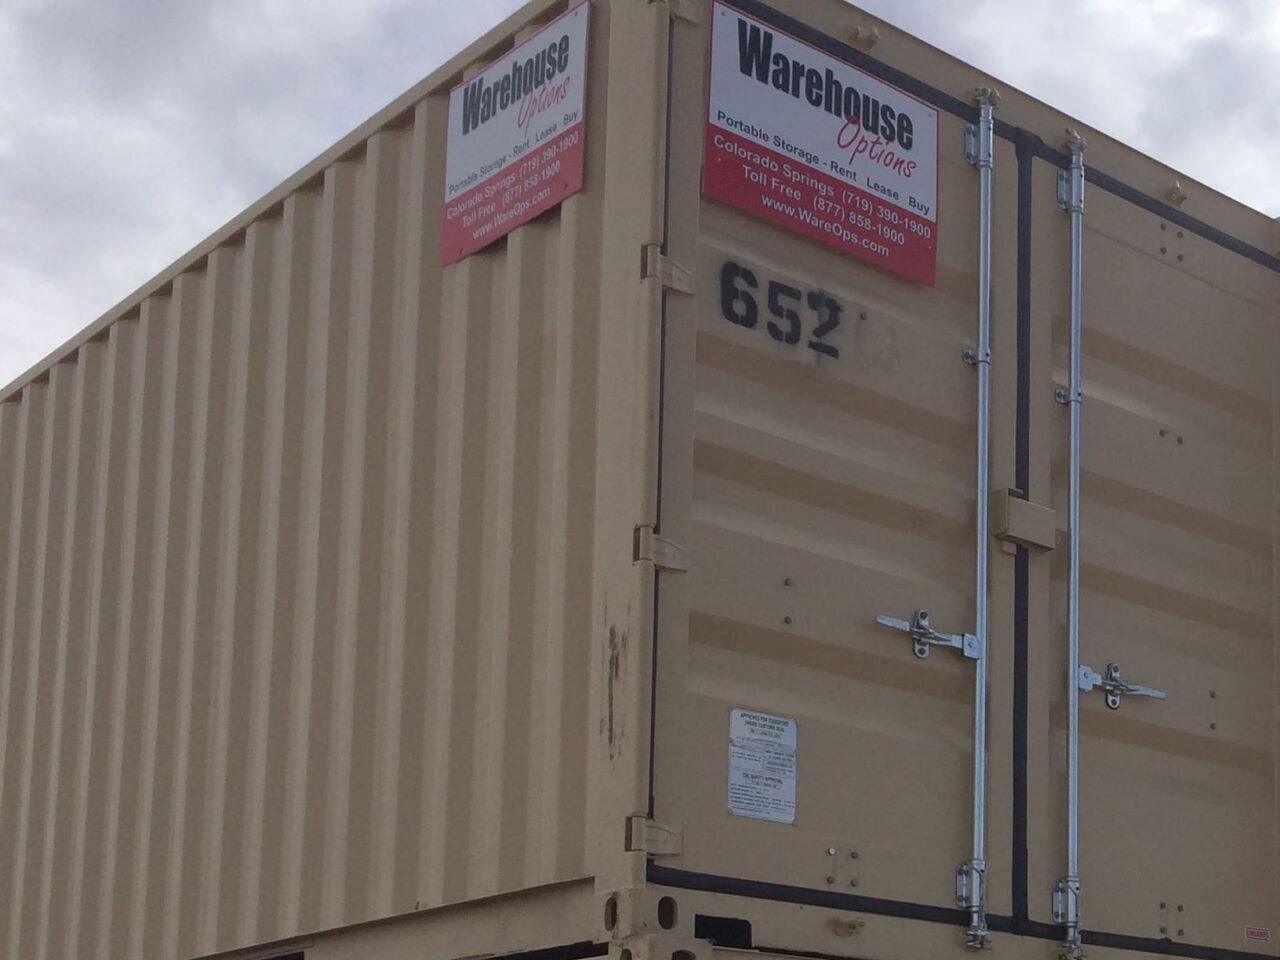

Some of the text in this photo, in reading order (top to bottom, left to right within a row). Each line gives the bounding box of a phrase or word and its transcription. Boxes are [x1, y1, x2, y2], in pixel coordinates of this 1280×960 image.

[462, 34, 569, 136] Warehouse
[518, 76, 570, 138] Options
[738, 18, 914, 151] Warehouse
[480, 156, 507, 179] Storage
[513, 140, 530, 156] Rent
[535, 124, 557, 142] Lease
[563, 111, 578, 126] Buy
[717, 110, 769, 142] Portable
[773, 135, 819, 169] Storage
[830, 161, 857, 182] Rent
[866, 177, 899, 201] Lease
[908, 196, 930, 215] Buy
[837, 112, 917, 178] Options
[447, 192, 482, 220] Colorado
[484, 173, 516, 198] Springs
[462, 213, 477, 227] Toll
[479, 203, 496, 220] Free
[714, 134, 931, 239] Colorado Springs (719) 390-1900
[742, 164, 905, 245] Toll Free (877) 858-1900
[761, 195, 889, 257] www.WareOps.com
[720, 261, 842, 359] 652
